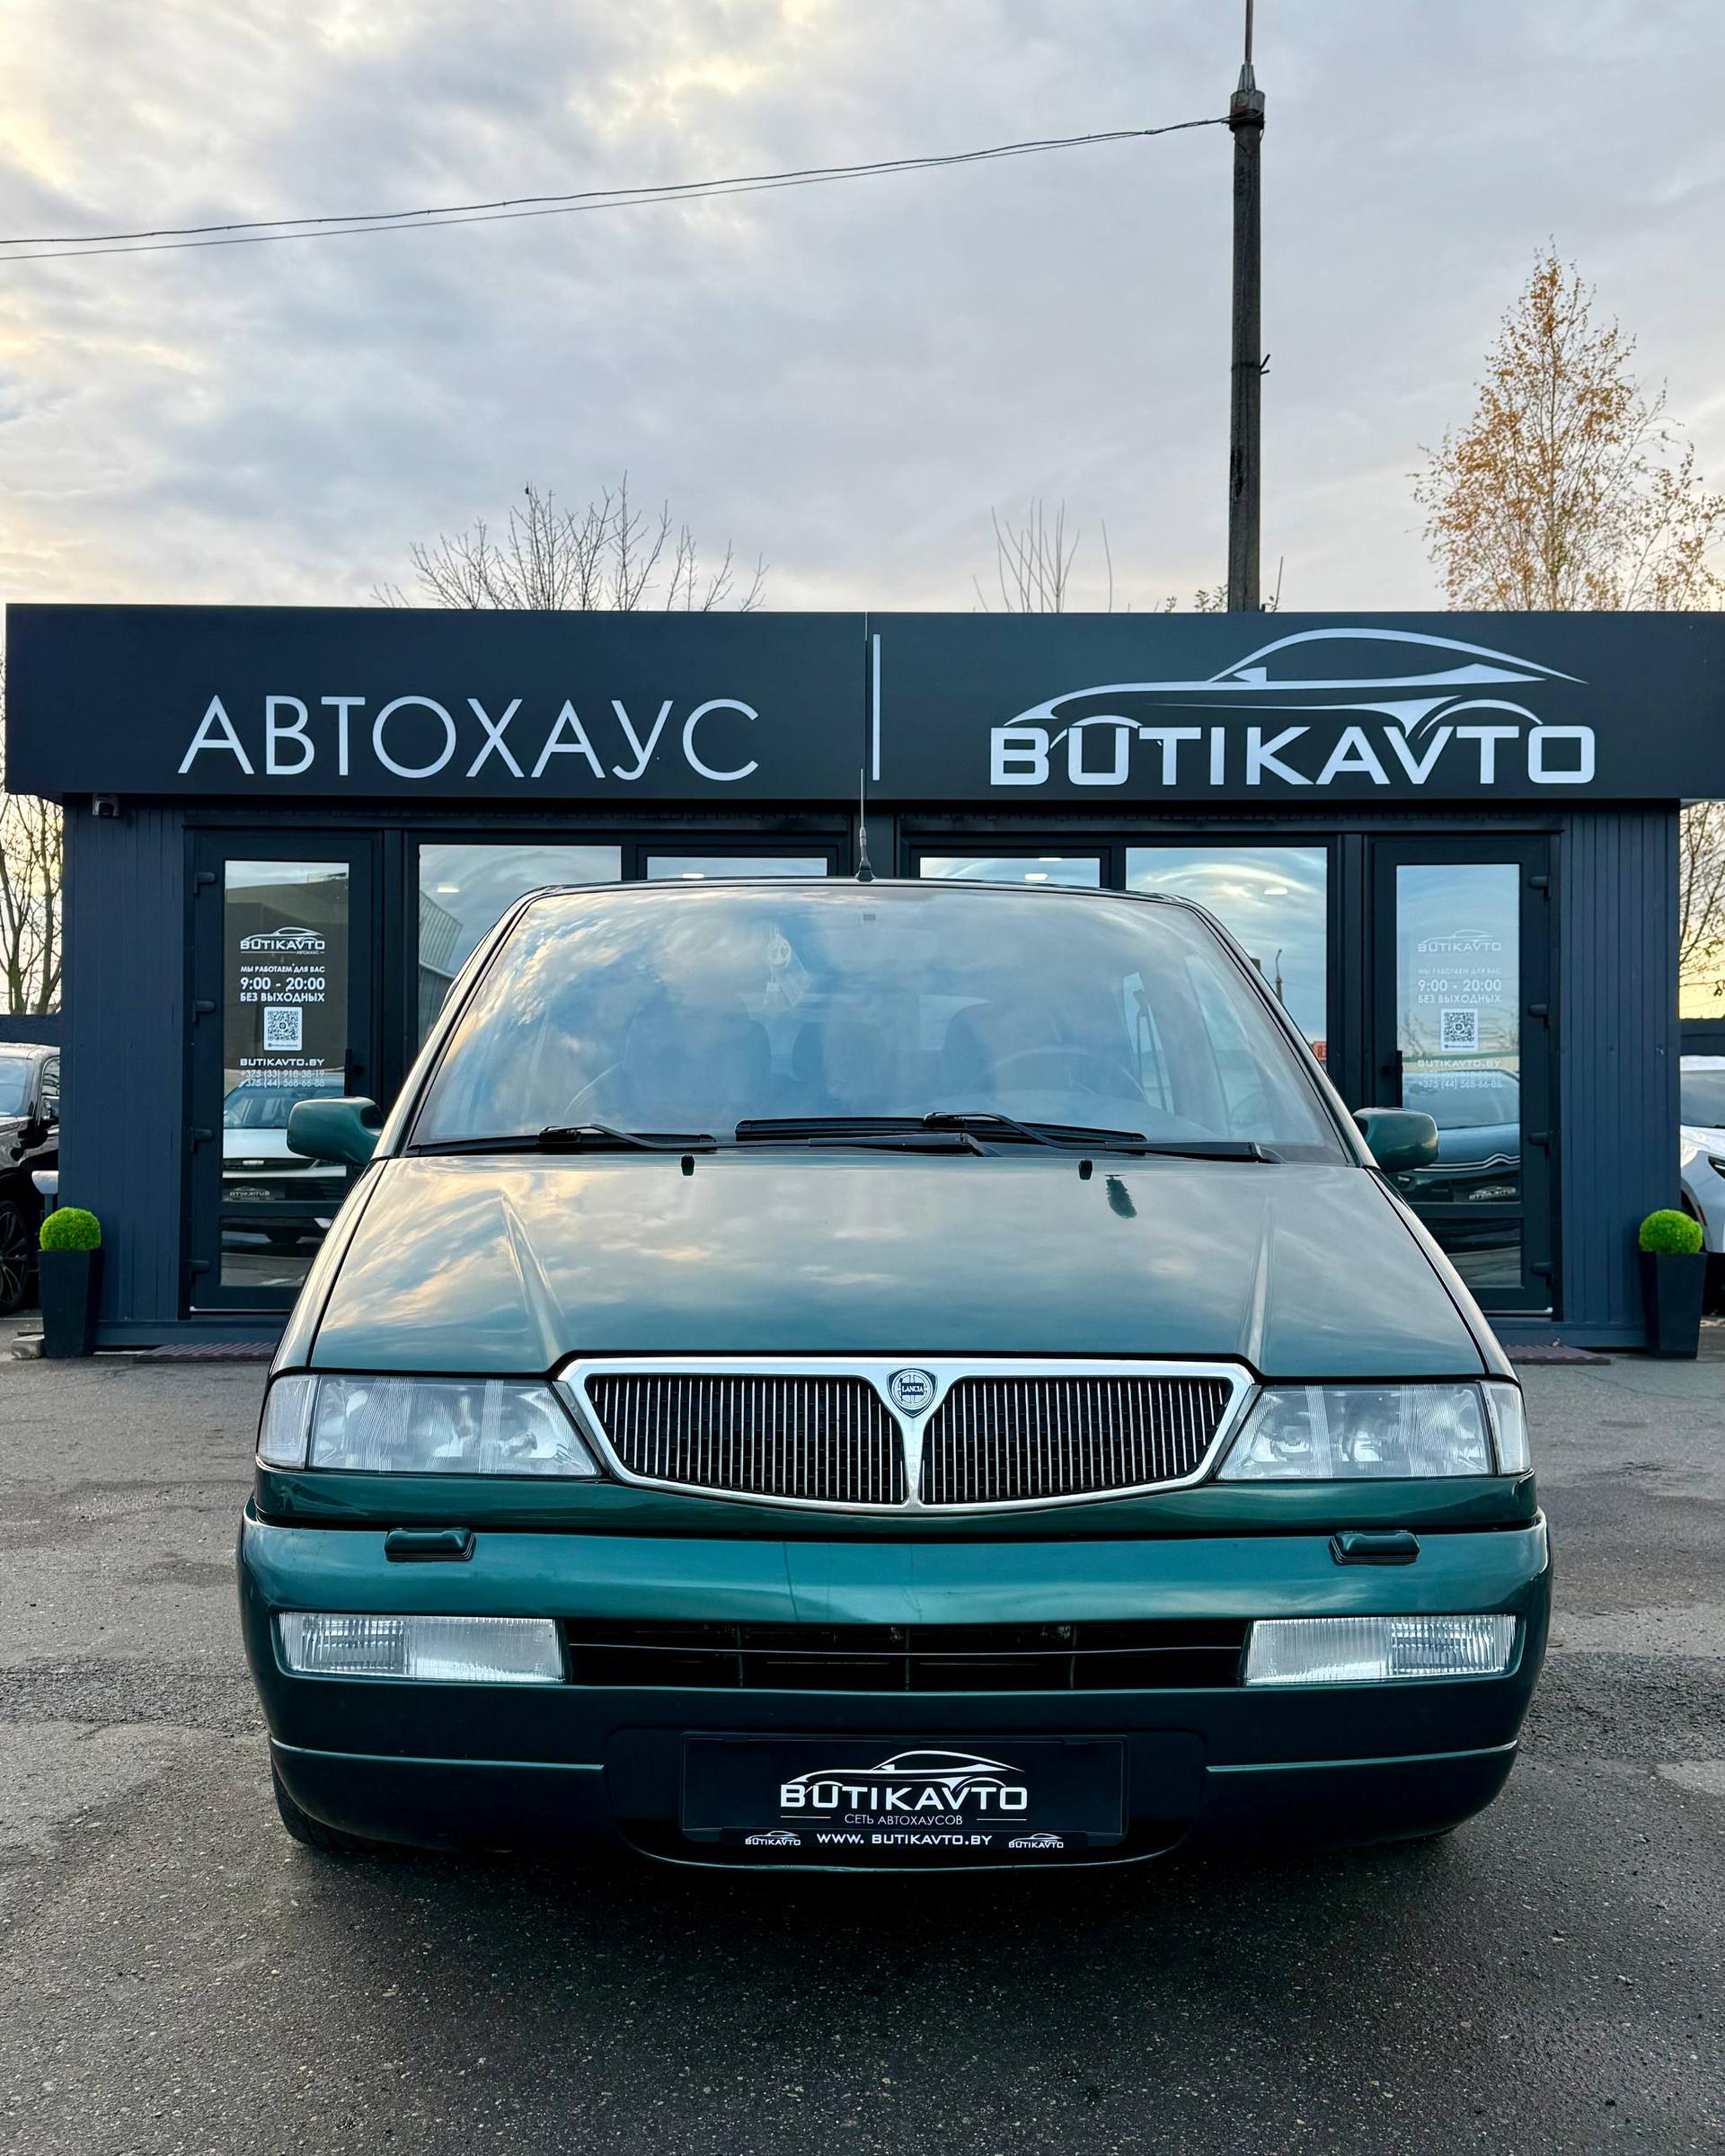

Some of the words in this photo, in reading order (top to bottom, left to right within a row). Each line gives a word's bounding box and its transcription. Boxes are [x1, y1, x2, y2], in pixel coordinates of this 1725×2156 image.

[178, 694, 759, 781] АВТОХАУС
[990, 725, 1596, 786] BUTIKAVTO
[240, 940, 325, 950] BUTIKAVTO
[1418, 941, 1501, 952] BUTIKAVTO
[240, 976, 271, 990] 9:00
[286, 976, 325, 992] 20:00
[1418, 979, 1447, 992] 9:00
[1463, 979, 1501, 992] 20:00
[240, 993, 258, 1002] БЕЗ
[261, 993, 325, 1003] ВЫХОДНЫХ
[1418, 994, 1435, 1003] БЕЗ
[1438, 994, 1501, 1004] ВЫХОДНЫХ
[240, 1058, 324, 1066] BUTIKAVTO.BY
[263, 1078, 280, 1089] (44)
[780, 1784, 1028, 1810] BUTIKAVTO
[845, 1814, 874, 1825] СЕТЬ
[878, 1815, 963, 1825] АВТОХАУСОВ
[745, 1838, 801, 1846] BUTIKAVTO
[817, 1833, 864, 1843] WWW.
[871, 1833, 992, 1845] BUTIKAVTO.BY
